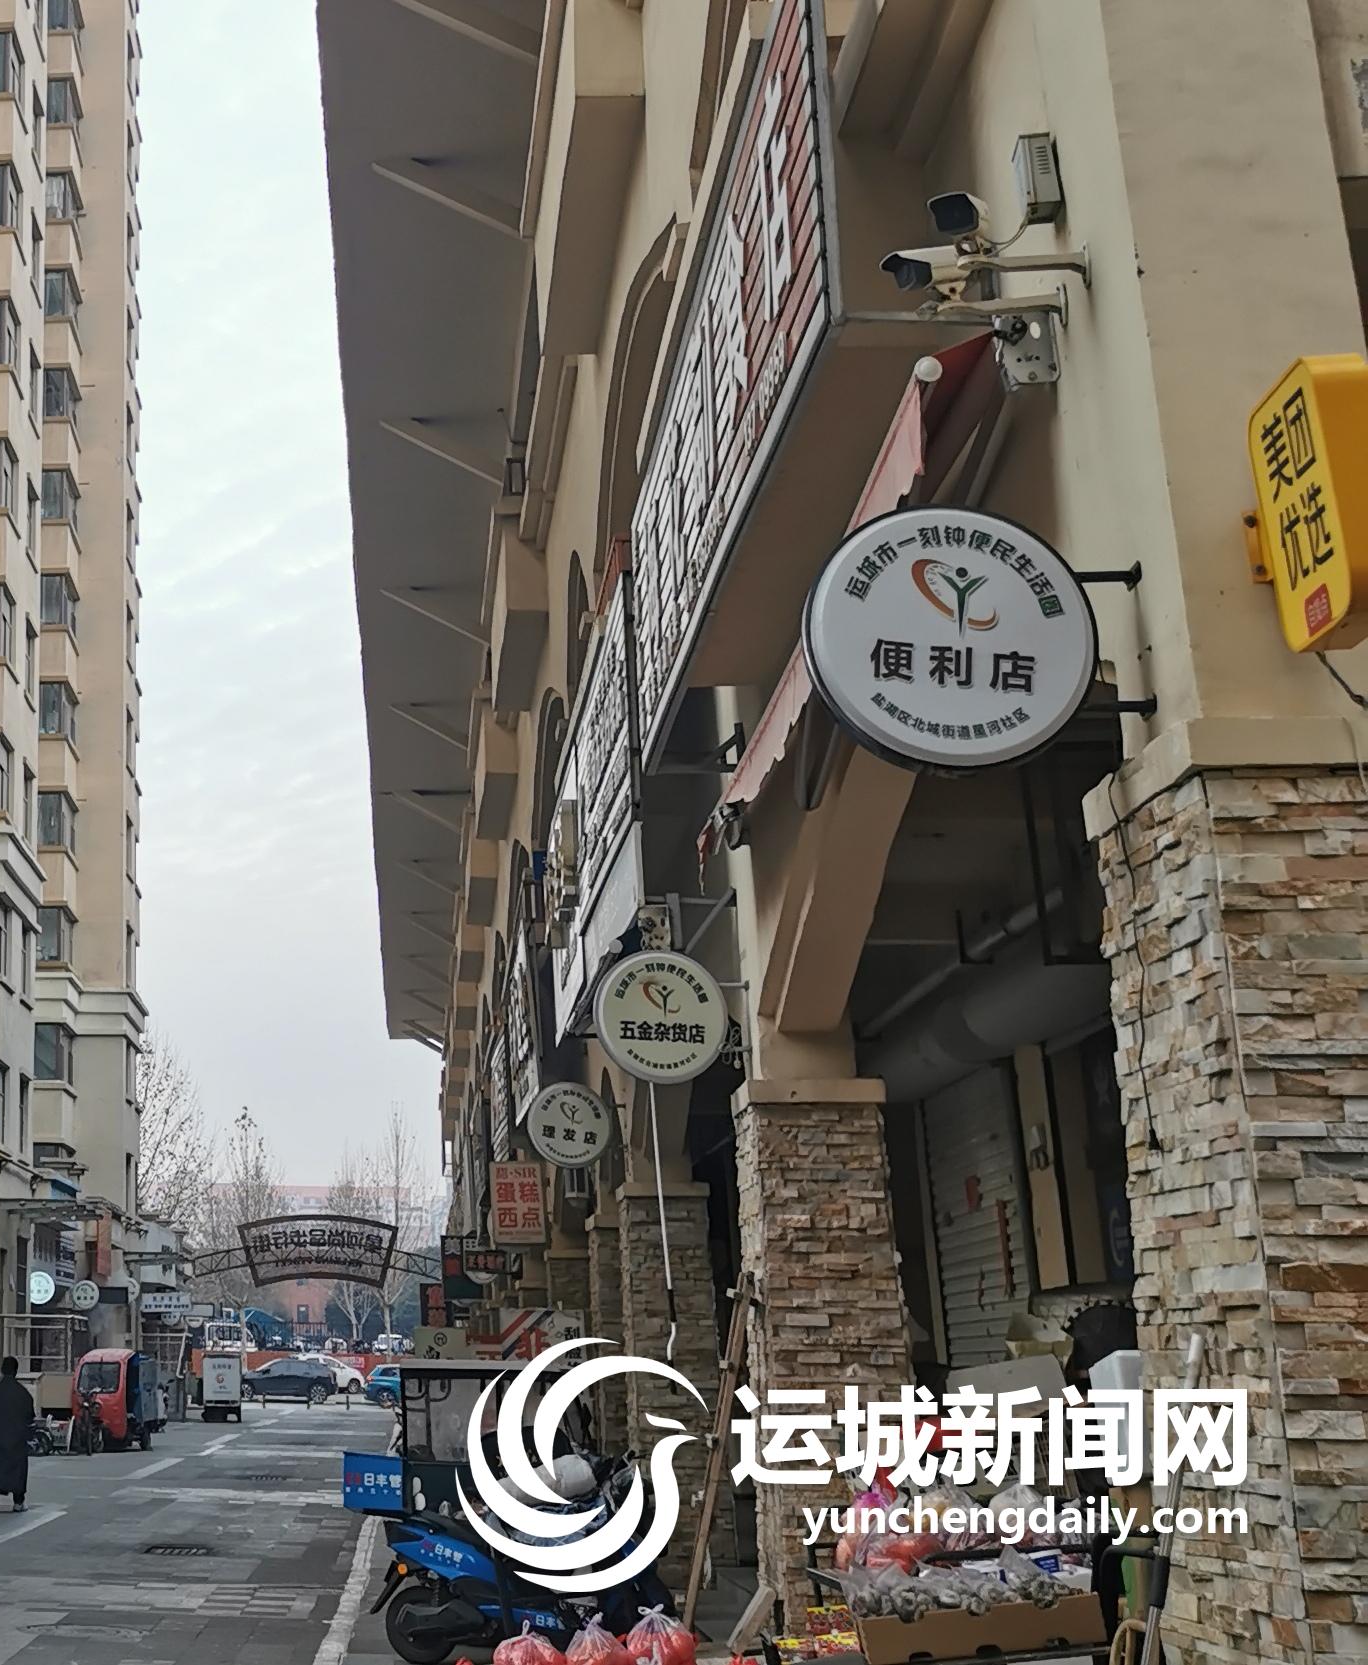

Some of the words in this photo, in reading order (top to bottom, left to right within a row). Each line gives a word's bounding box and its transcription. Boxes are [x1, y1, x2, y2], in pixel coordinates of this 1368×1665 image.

[1260, 386, 1317, 504] 美团
[1280, 480, 1335, 592] 优选
[844, 526, 1065, 619] 运城市一刻钟便民生活圈
[870, 638, 1036, 693] 便利店
[620, 1021, 705, 1044] 五金杂货店
[542, 1125, 597, 1145] 理发店
[496, 1181, 540, 1203] 蛋糕
[497, 1207, 541, 1228] 西点
